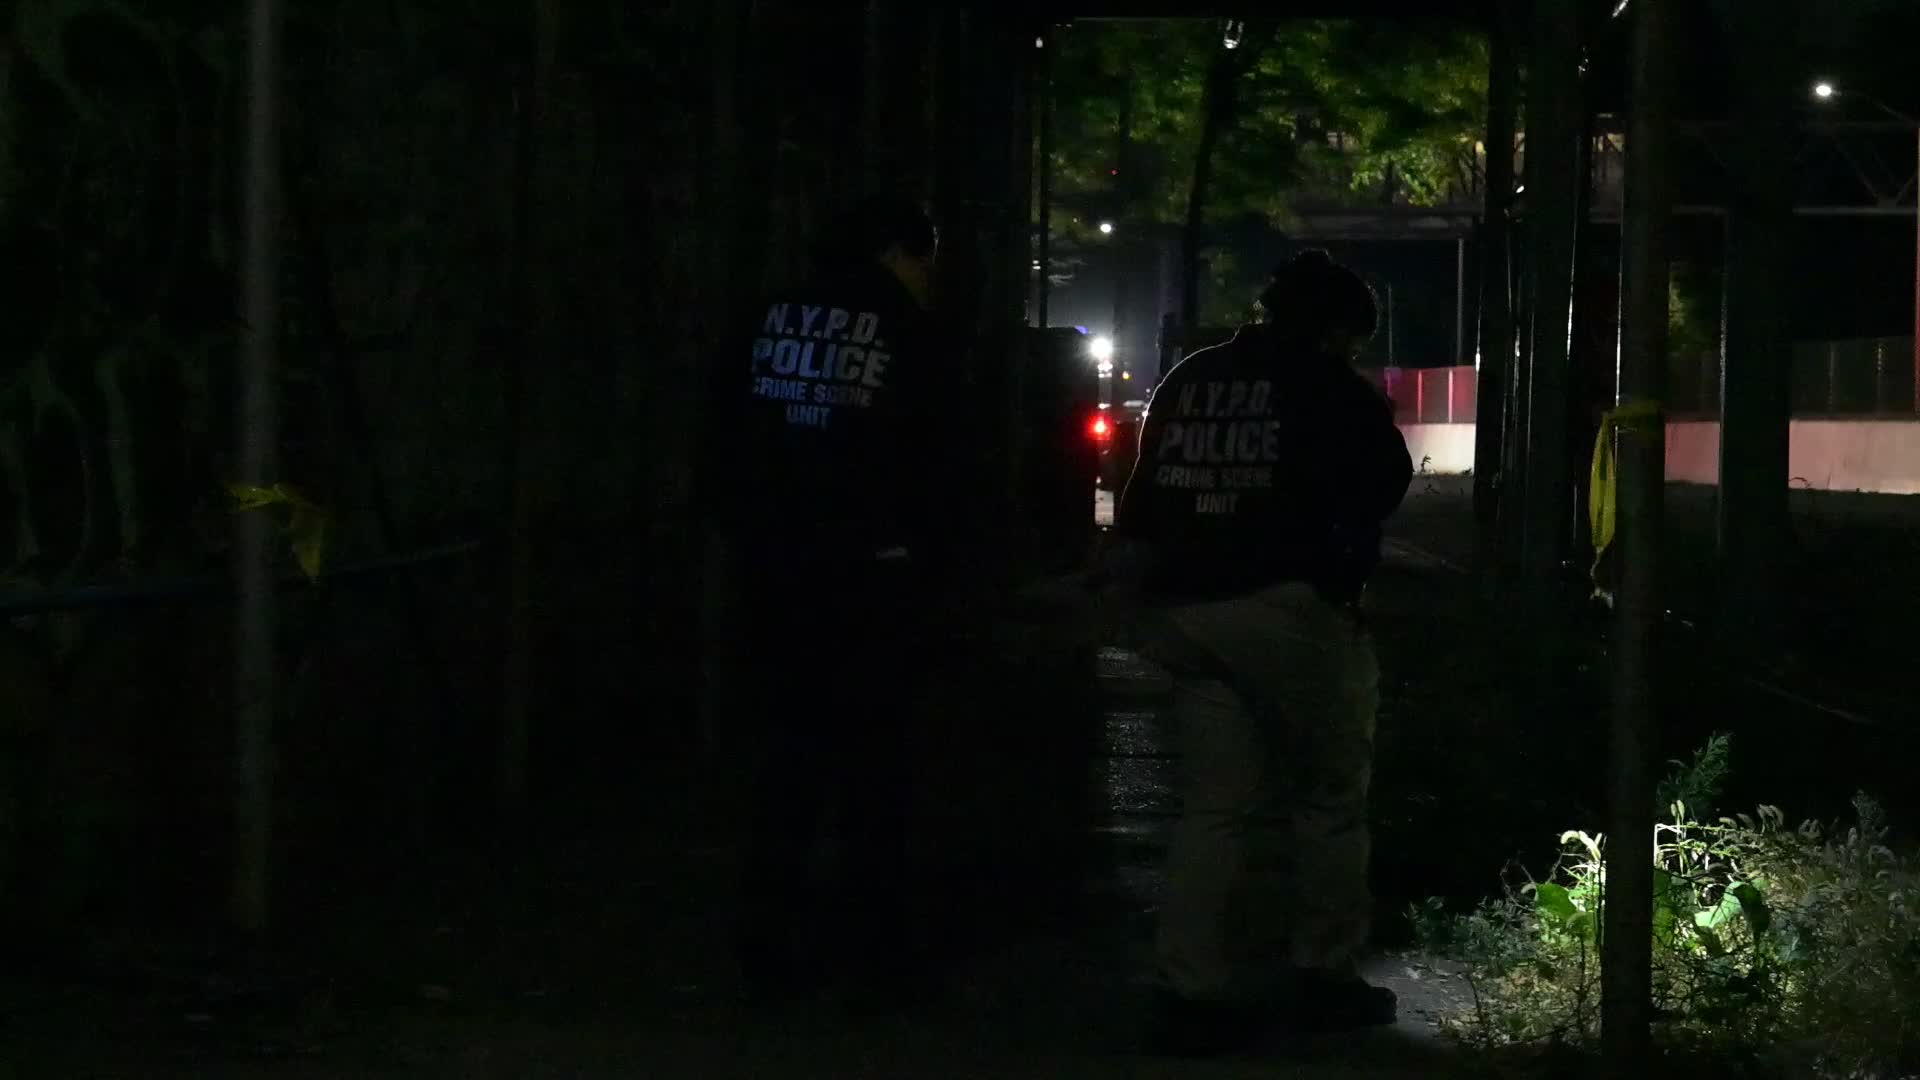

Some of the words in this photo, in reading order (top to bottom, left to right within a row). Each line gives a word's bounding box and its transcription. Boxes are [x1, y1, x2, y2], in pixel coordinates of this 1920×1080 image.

[752, 337, 891, 388] POLICE
[785, 403, 831, 430] UNIT
[1157, 420, 1280, 463] POLICE
[1156, 465, 1216, 489] CRIME
[1196, 493, 1239, 513] UNIT
